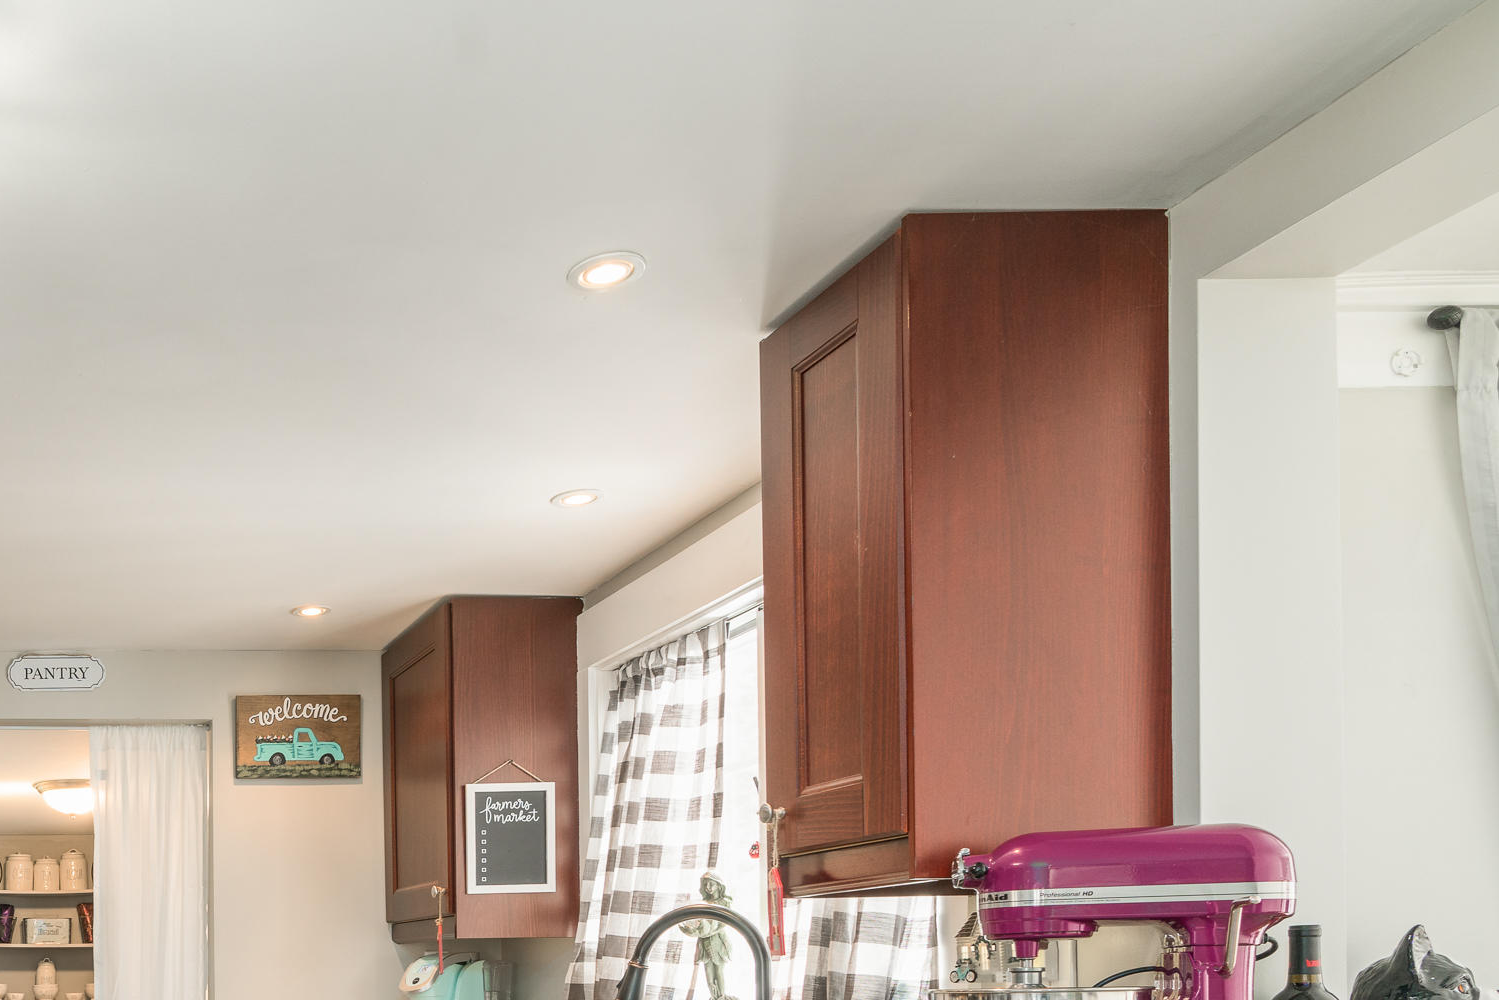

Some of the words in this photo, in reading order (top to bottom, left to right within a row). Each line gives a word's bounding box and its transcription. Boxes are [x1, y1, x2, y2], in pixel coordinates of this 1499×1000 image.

[23, 666, 90, 681] PANTRY
[247, 696, 348, 726] welcome
[479, 796, 533, 824] farmers
[493, 808, 540, 824] market
[1039, 890, 1081, 898] Professional
